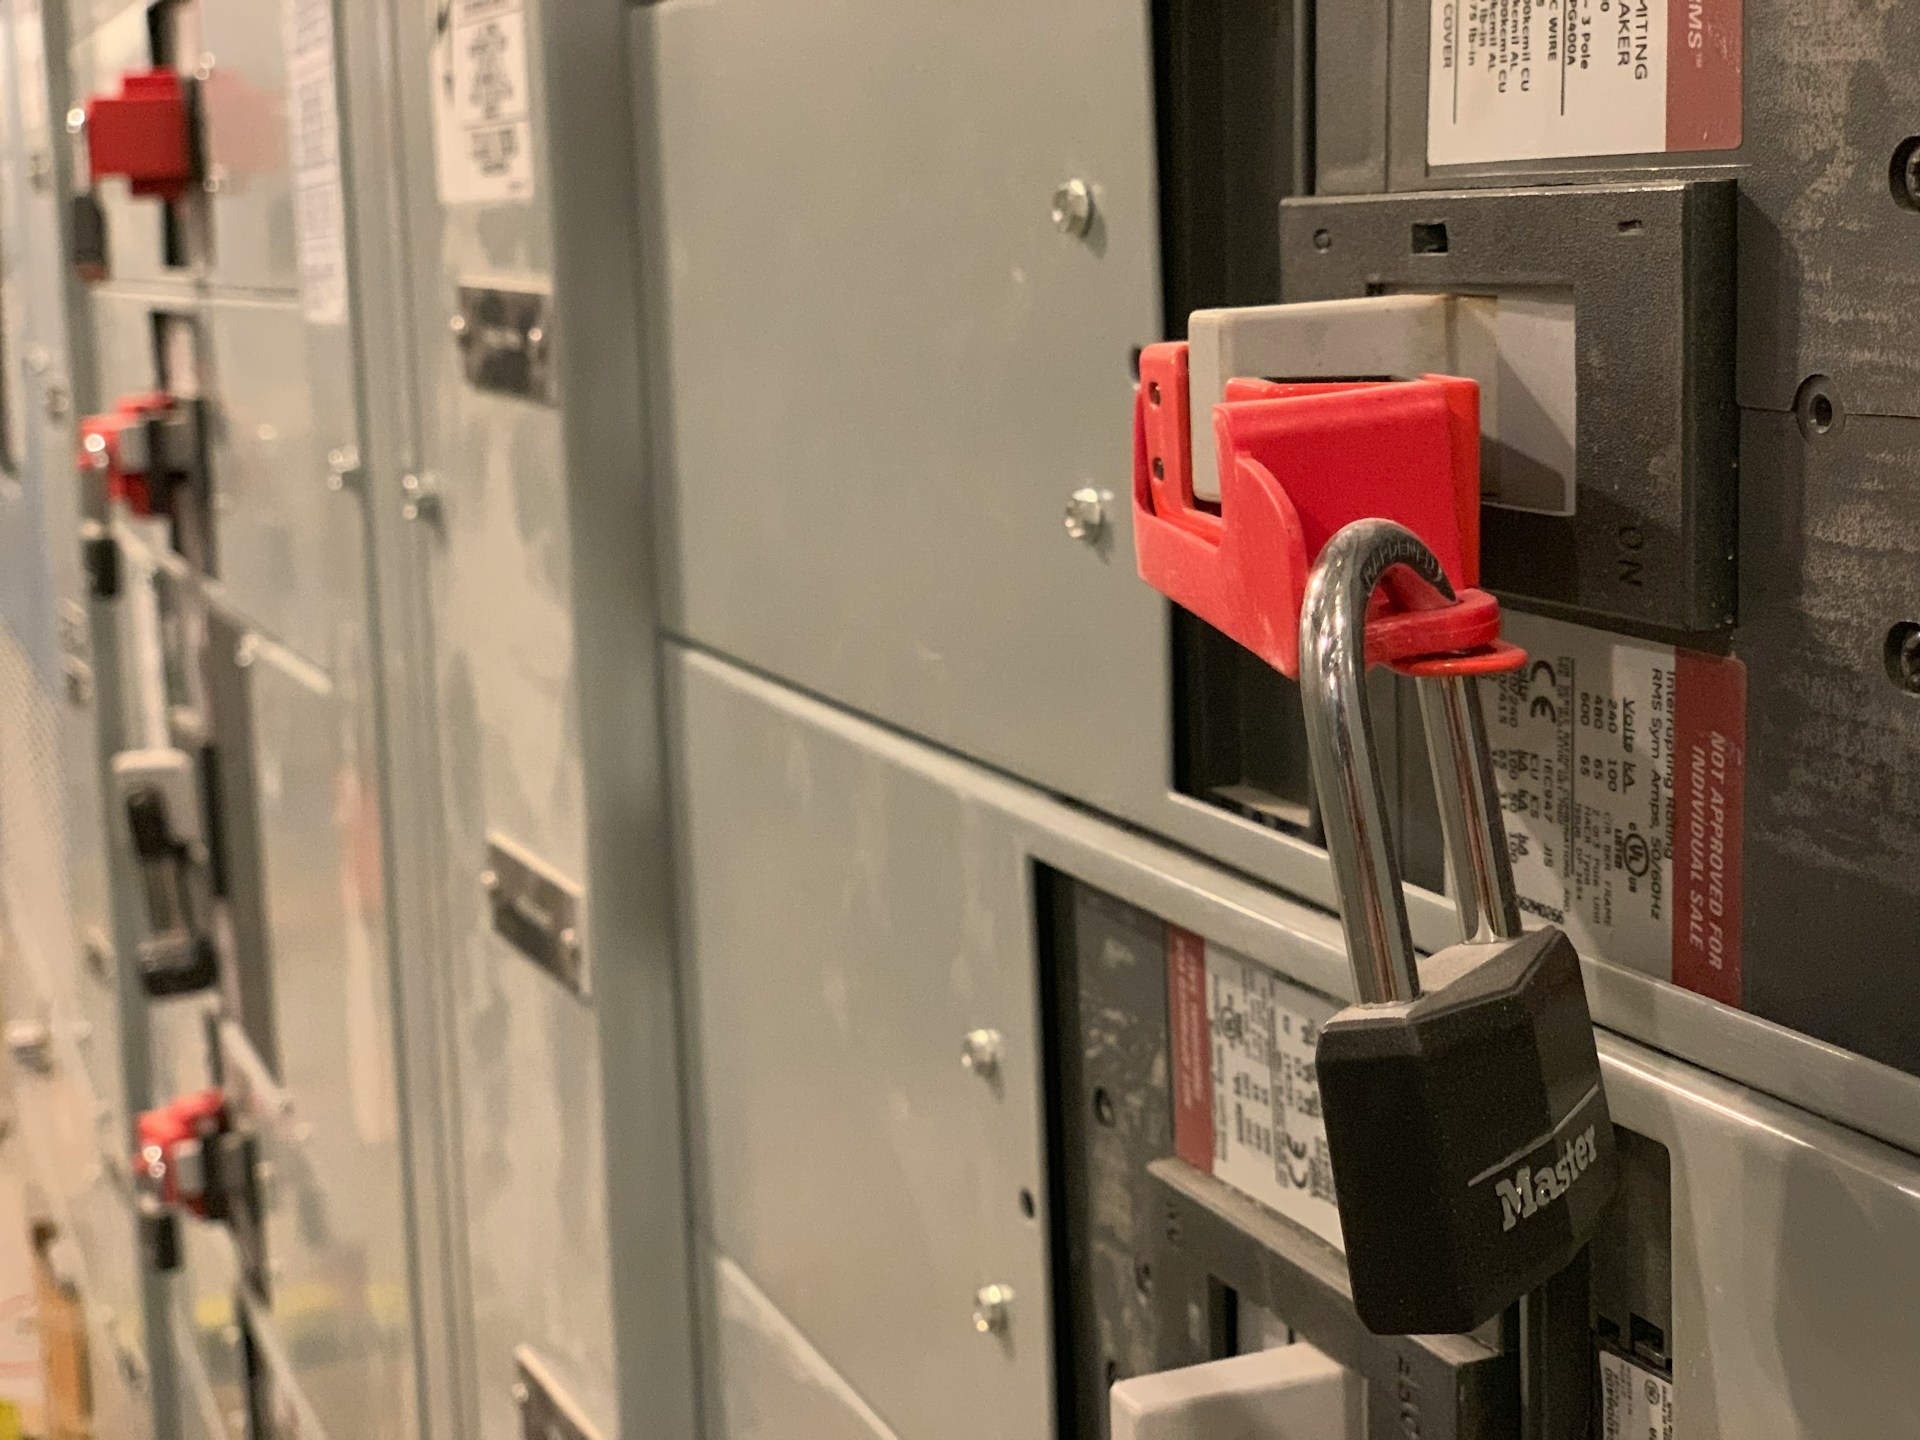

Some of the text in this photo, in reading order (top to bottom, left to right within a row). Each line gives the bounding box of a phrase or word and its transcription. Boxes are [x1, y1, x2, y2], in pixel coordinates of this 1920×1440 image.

[1443, 4, 1453, 69] COVER
[1488, 0, 1497, 73] kcmil AL
[1548, 17, 1558, 62] WIRE
[1580, 32, 1591, 70] Pole
[1581, 15, 1591, 26] 3
[1617, 0, 1631, 66] AKER
[1498, 69, 1507, 94] CU
[1510, 51, 1519, 72] AL
[1520, 67, 1530, 92] CU
[1619, 526, 1643, 587] ON
[1651, 669, 1662, 711] RMS
[1580, 692, 1590, 777] 600 65
[1594, 695, 1603, 780] 480 65
[1607, 699, 1617, 792] 240 100
[1623, 698, 1636, 789] Volts kA
[1649, 769, 1661, 829] Amps,
[1614, 829, 1622, 869] LISTED
[1650, 837, 1662, 921] 50/60Hz
[1689, 746, 1705, 951] INDIVIDUAL SALE
[1708, 730, 1725, 970] NOT APPROVED FOR
[1495, 1124, 1596, 1232] Master
